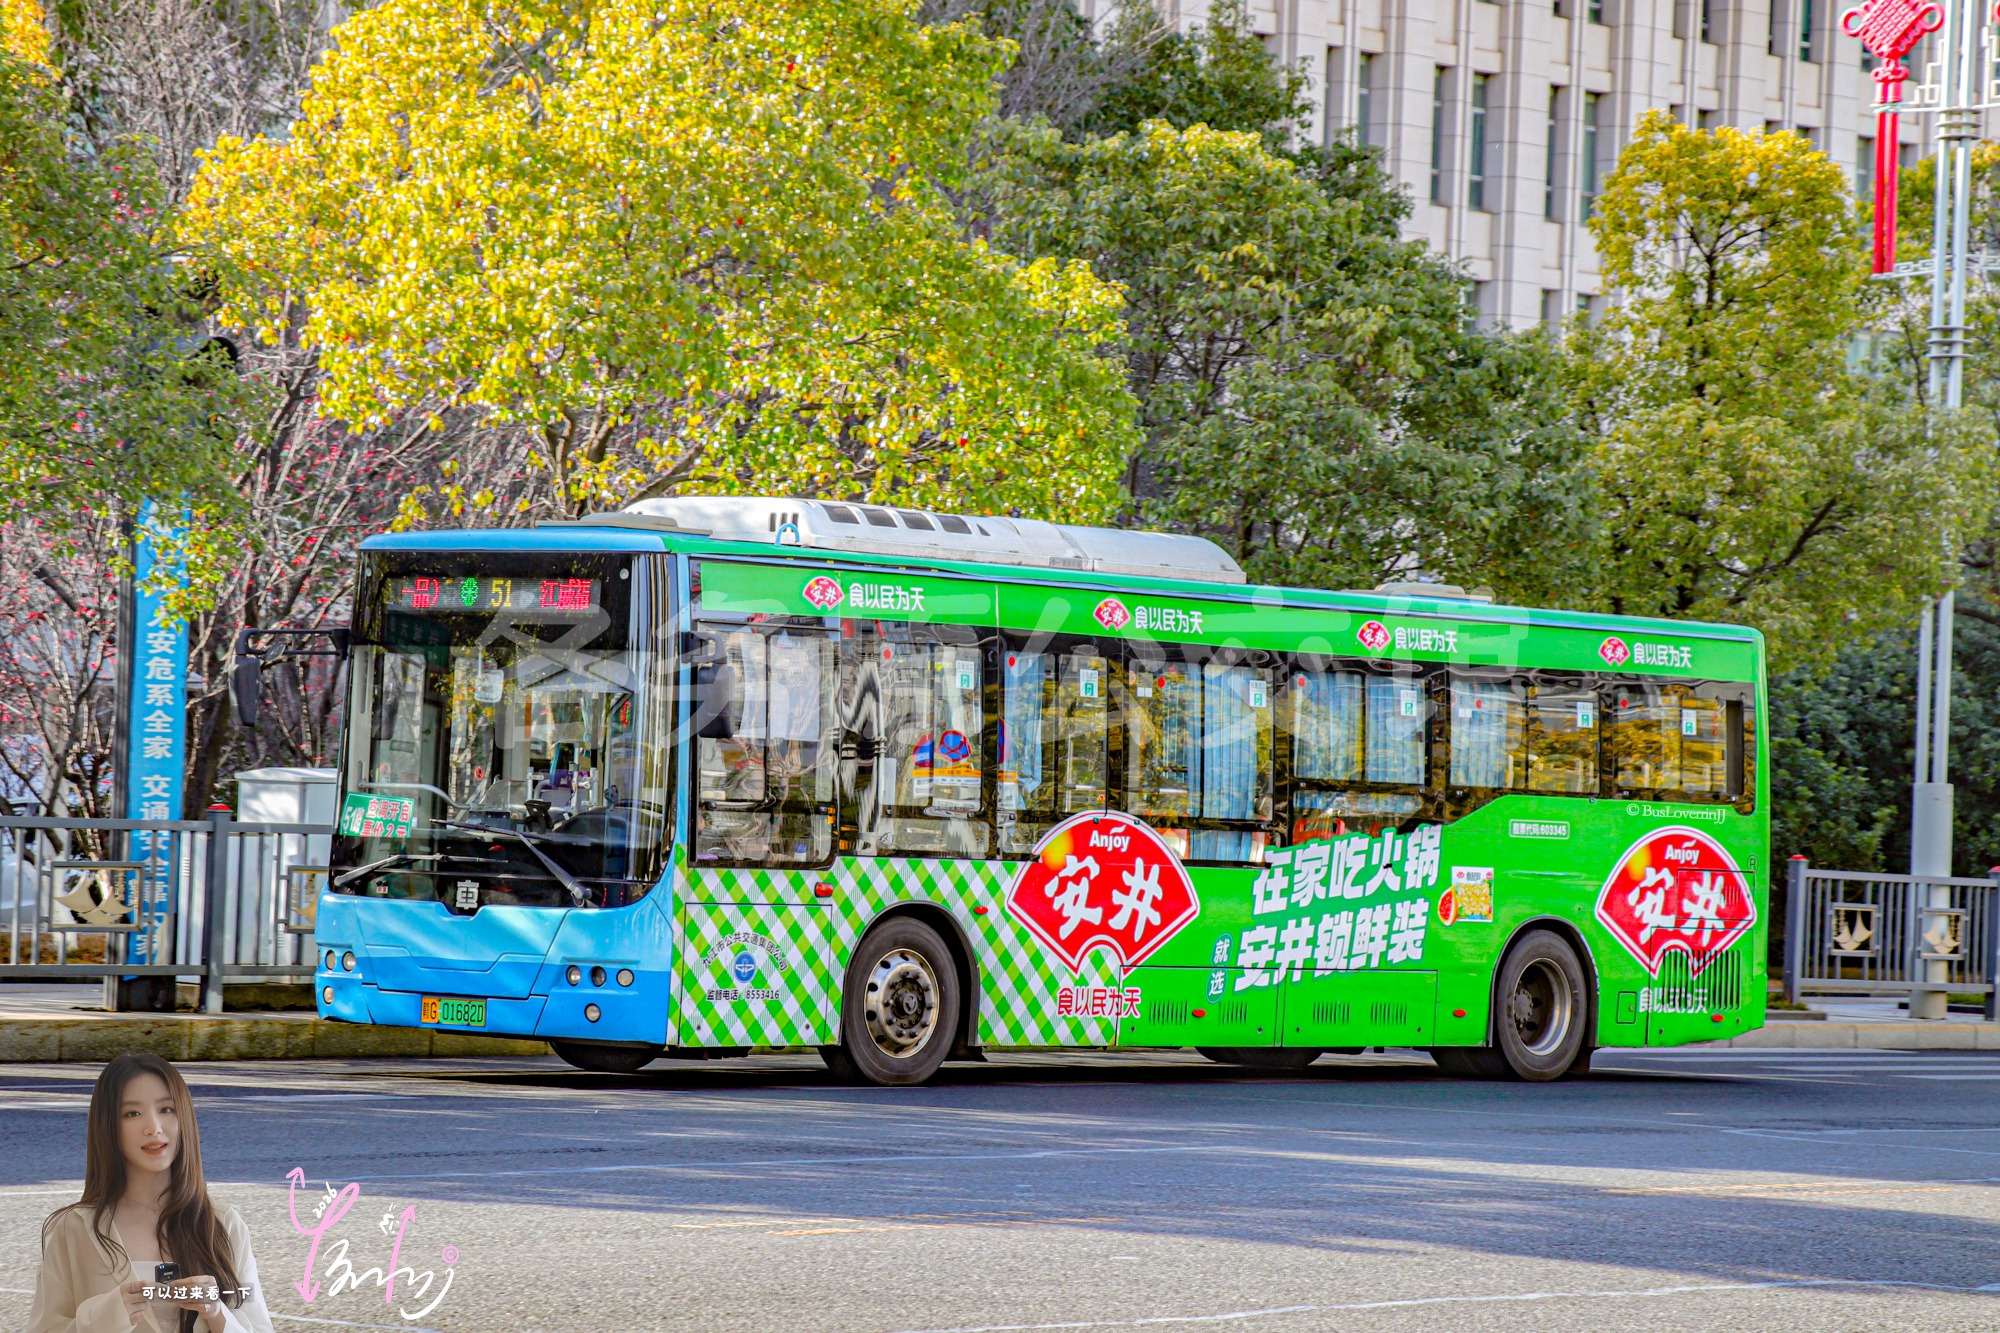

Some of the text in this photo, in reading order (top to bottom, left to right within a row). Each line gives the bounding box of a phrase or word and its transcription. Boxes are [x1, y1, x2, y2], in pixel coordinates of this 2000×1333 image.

[490, 579, 513, 608] 51
[811, 585, 837, 603] 安井
[849, 583, 925, 612] 食以民为天
[1100, 606, 1124, 625] 安井
[1134, 605, 1204, 635] 食以民为天
[1363, 628, 1385, 646] 安井
[1394, 625, 1458, 654] 食以民为天
[1632, 641, 1692, 669] 食以民为天
[366, 798, 411, 823] 空调开启
[1089, 826, 1131, 852] Anjoy
[1664, 841, 1701, 864] Anjoy
[1252, 824, 1443, 916] 在家吃火锅
[1044, 854, 1164, 943] 安井
[1628, 867, 1726, 947] 安井
[702, 931, 789, 972] 九江市公共交通集团公司
[1234, 897, 1430, 992] 安井锁鲜装
[1208, 939, 1230, 996] 就选
[1056, 986, 1142, 1019] 食以民为天
